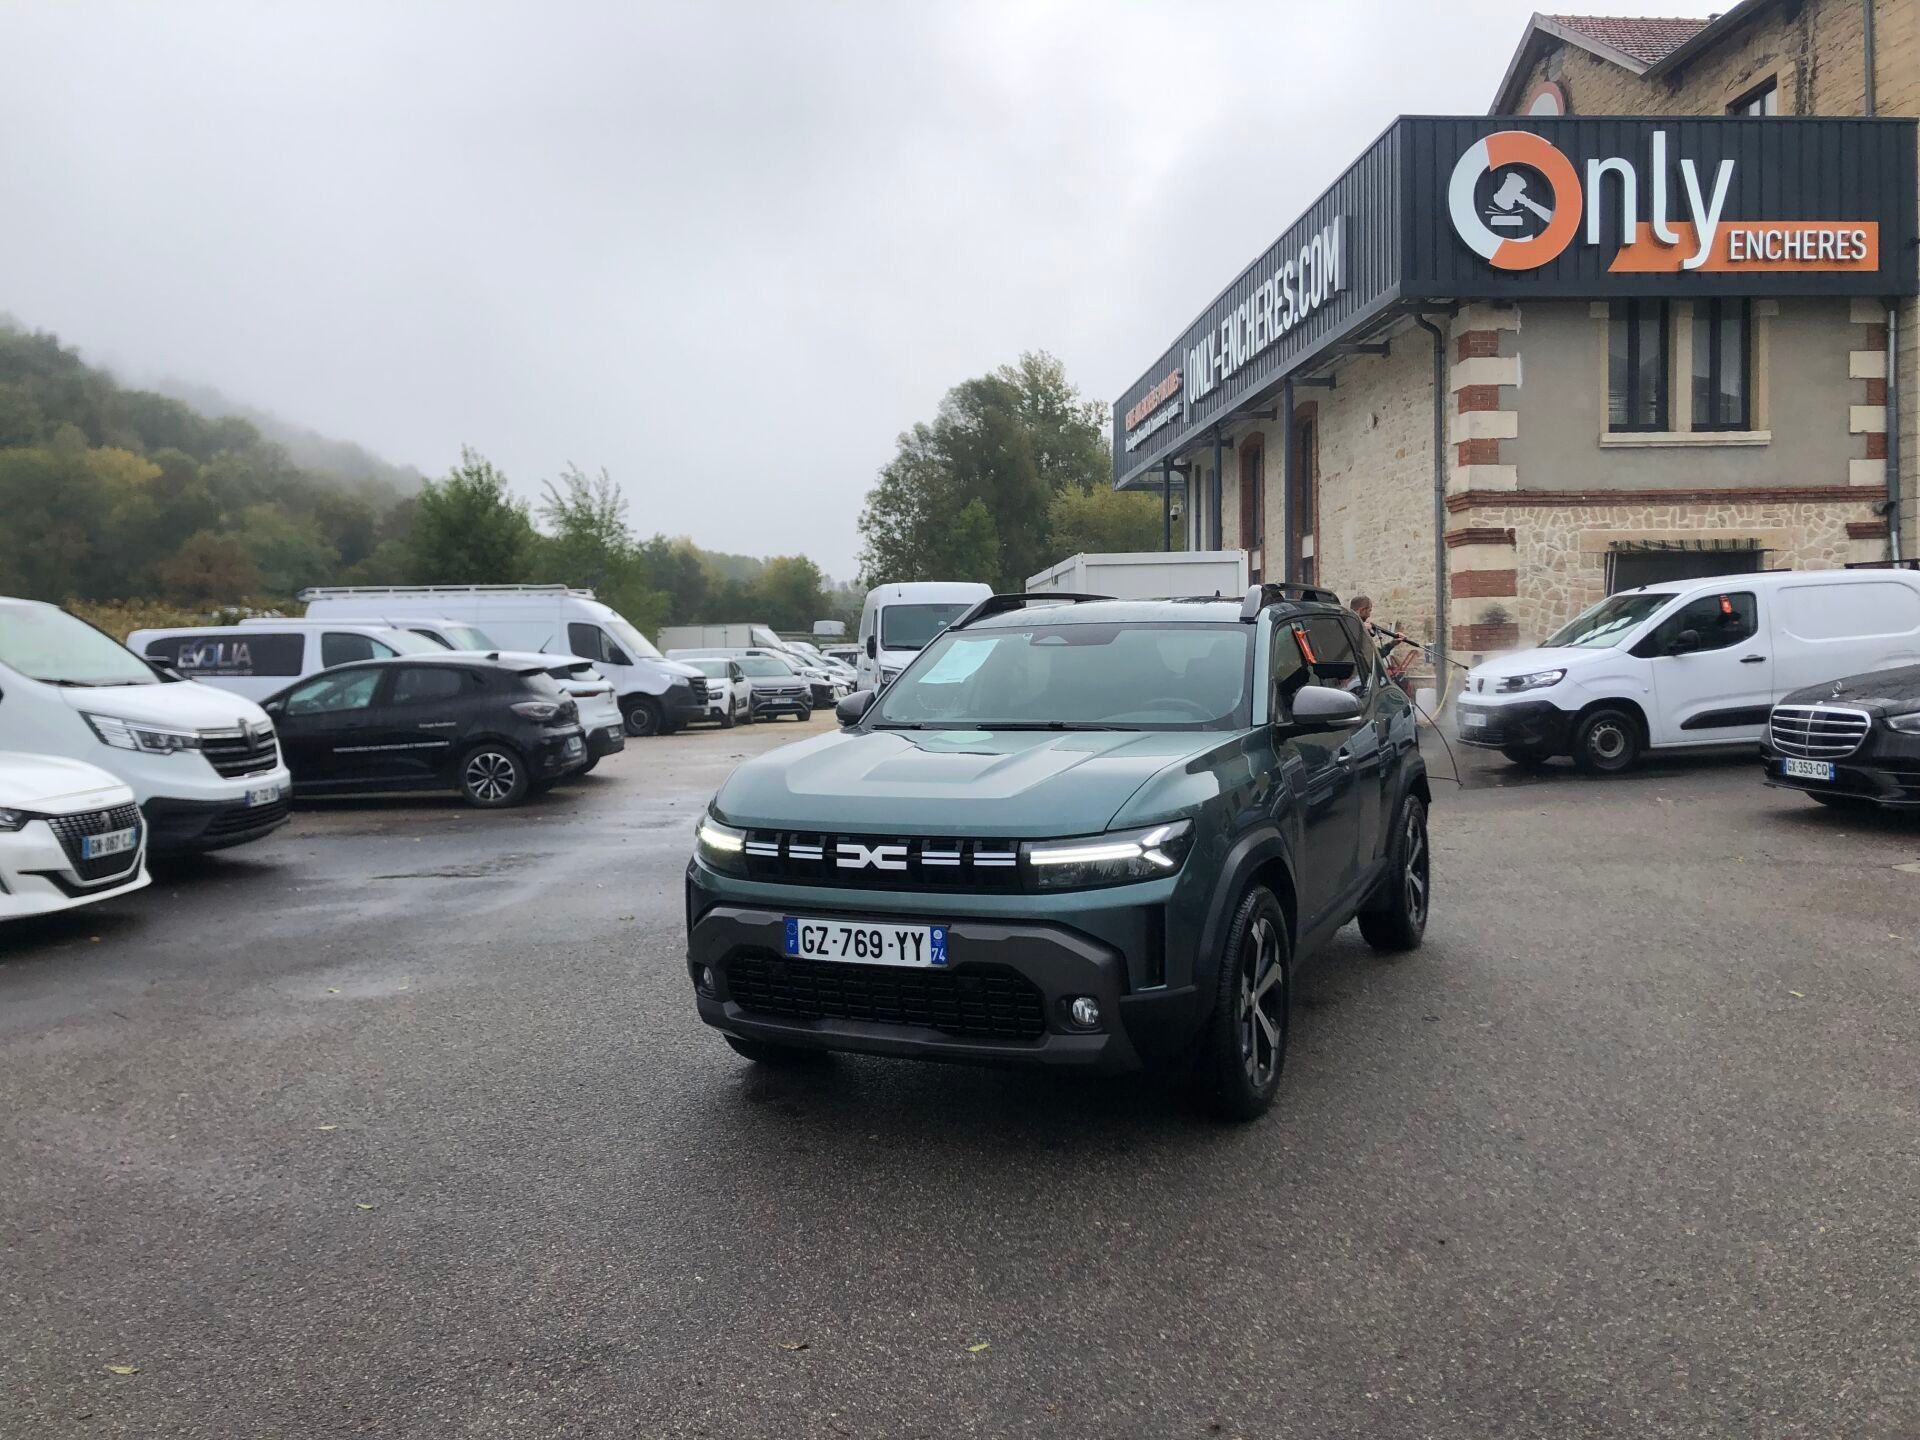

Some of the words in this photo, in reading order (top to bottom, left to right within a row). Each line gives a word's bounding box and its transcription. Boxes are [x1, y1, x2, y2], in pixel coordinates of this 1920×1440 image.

[1448, 130, 1735, 271] Only
[1729, 229, 1867, 261] ENCHERES
[1188, 215, 1342, 405] ONLY-ENCHERES.COM
[177, 642, 253, 668] EVOLIA
[789, 939, 795, 948] F
[801, 925, 924, 962] GZ-769-YY
[931, 946, 946, 962] 74
